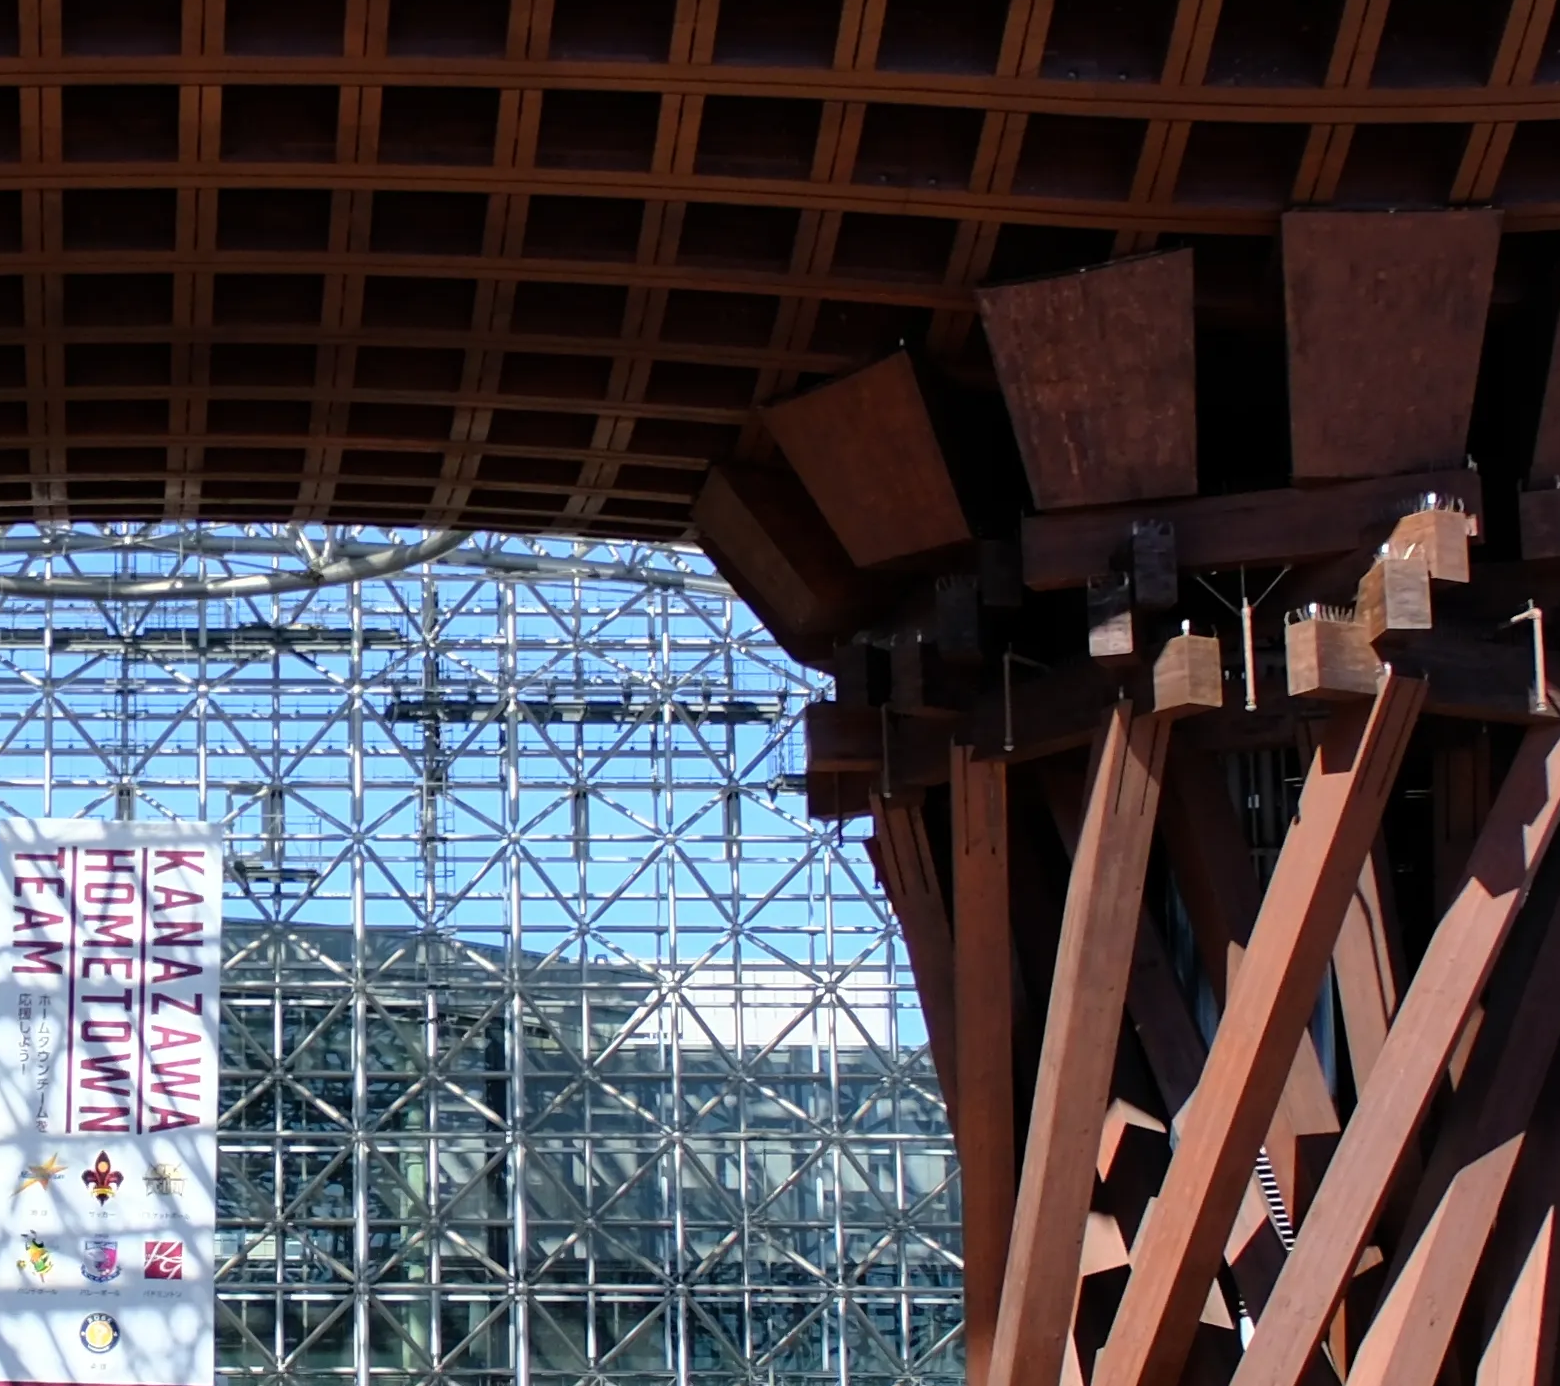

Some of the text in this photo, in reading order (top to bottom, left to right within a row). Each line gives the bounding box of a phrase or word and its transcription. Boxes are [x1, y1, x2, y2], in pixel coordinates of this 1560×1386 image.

[11, 847, 66, 975] TEAM
[78, 849, 136, 1133] HOMETOWN
[148, 850, 205, 1133] KANAZAWA
[36, 993, 52, 1133] ホームタウンチームを
